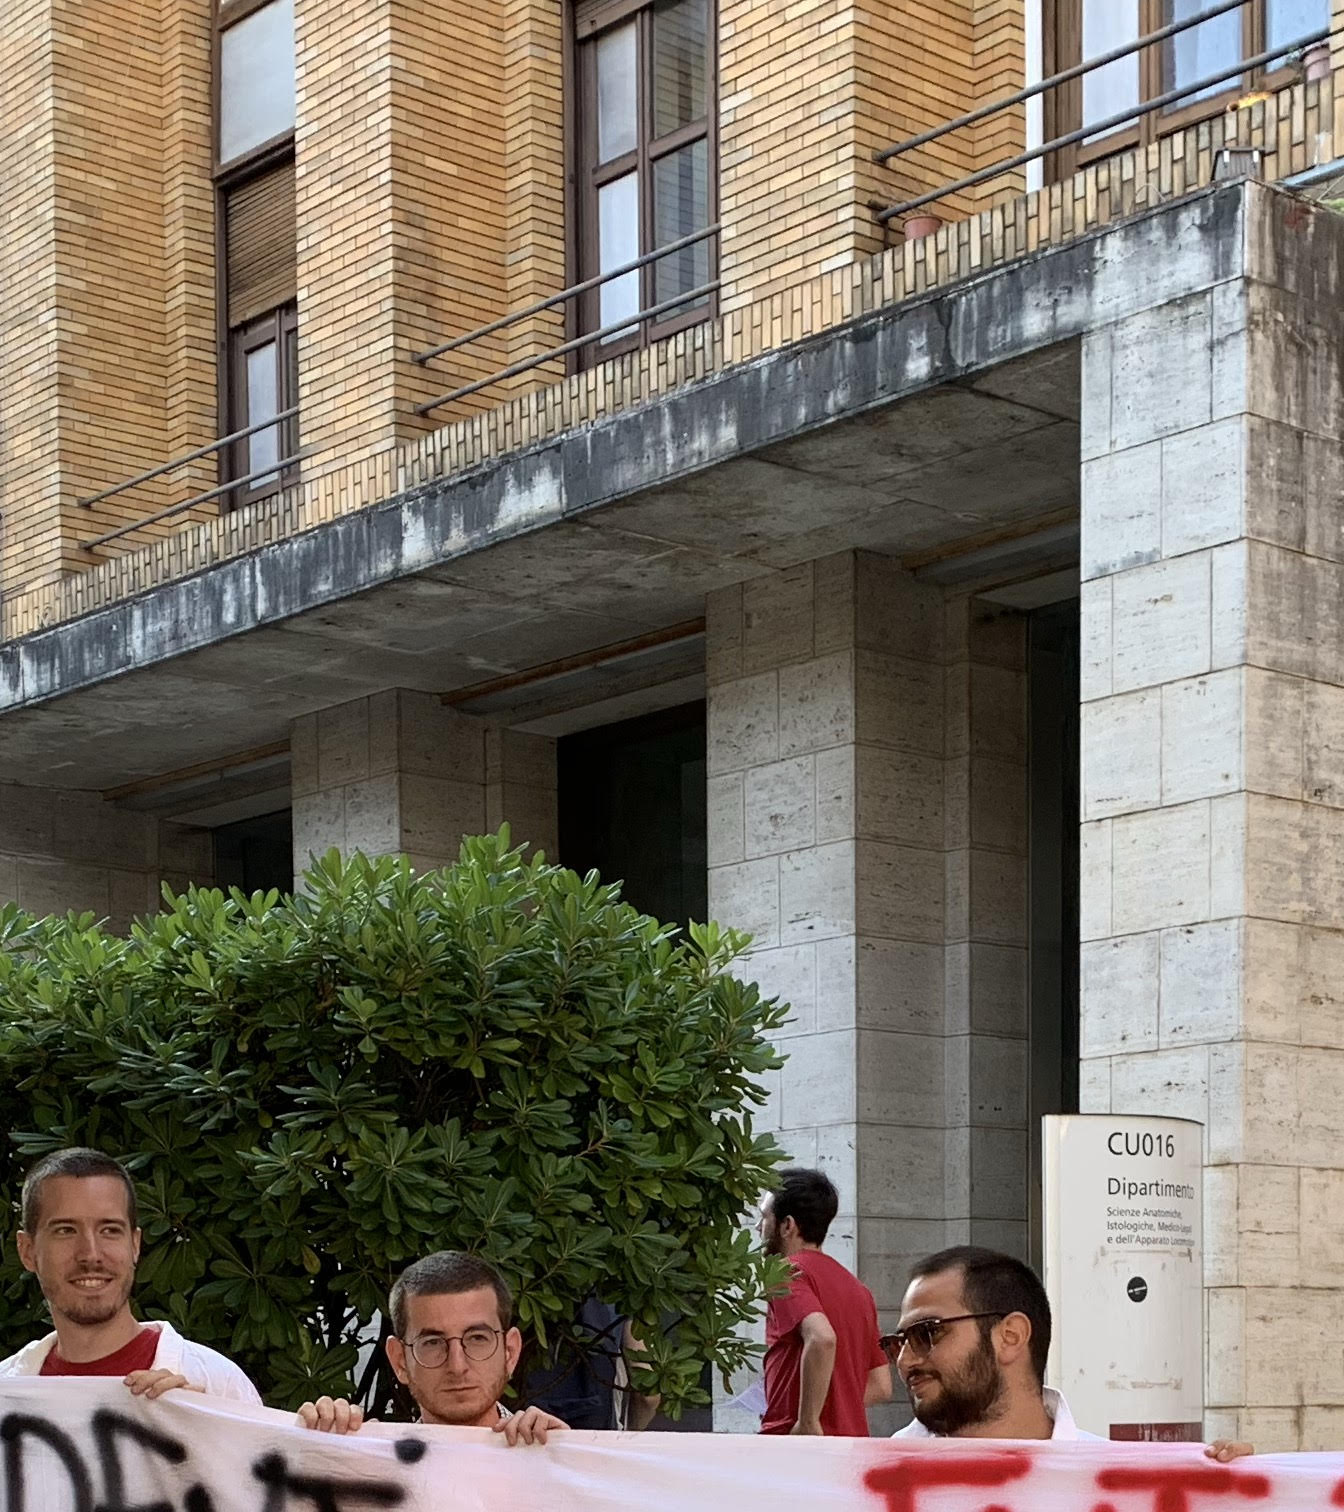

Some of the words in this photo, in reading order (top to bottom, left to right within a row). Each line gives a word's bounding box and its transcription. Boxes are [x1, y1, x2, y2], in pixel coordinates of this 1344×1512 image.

[1107, 1132, 1175, 1158] CU016
[1107, 1177, 1195, 1200] Dipartimento
[1107, 1206, 1141, 1217] Scienze
